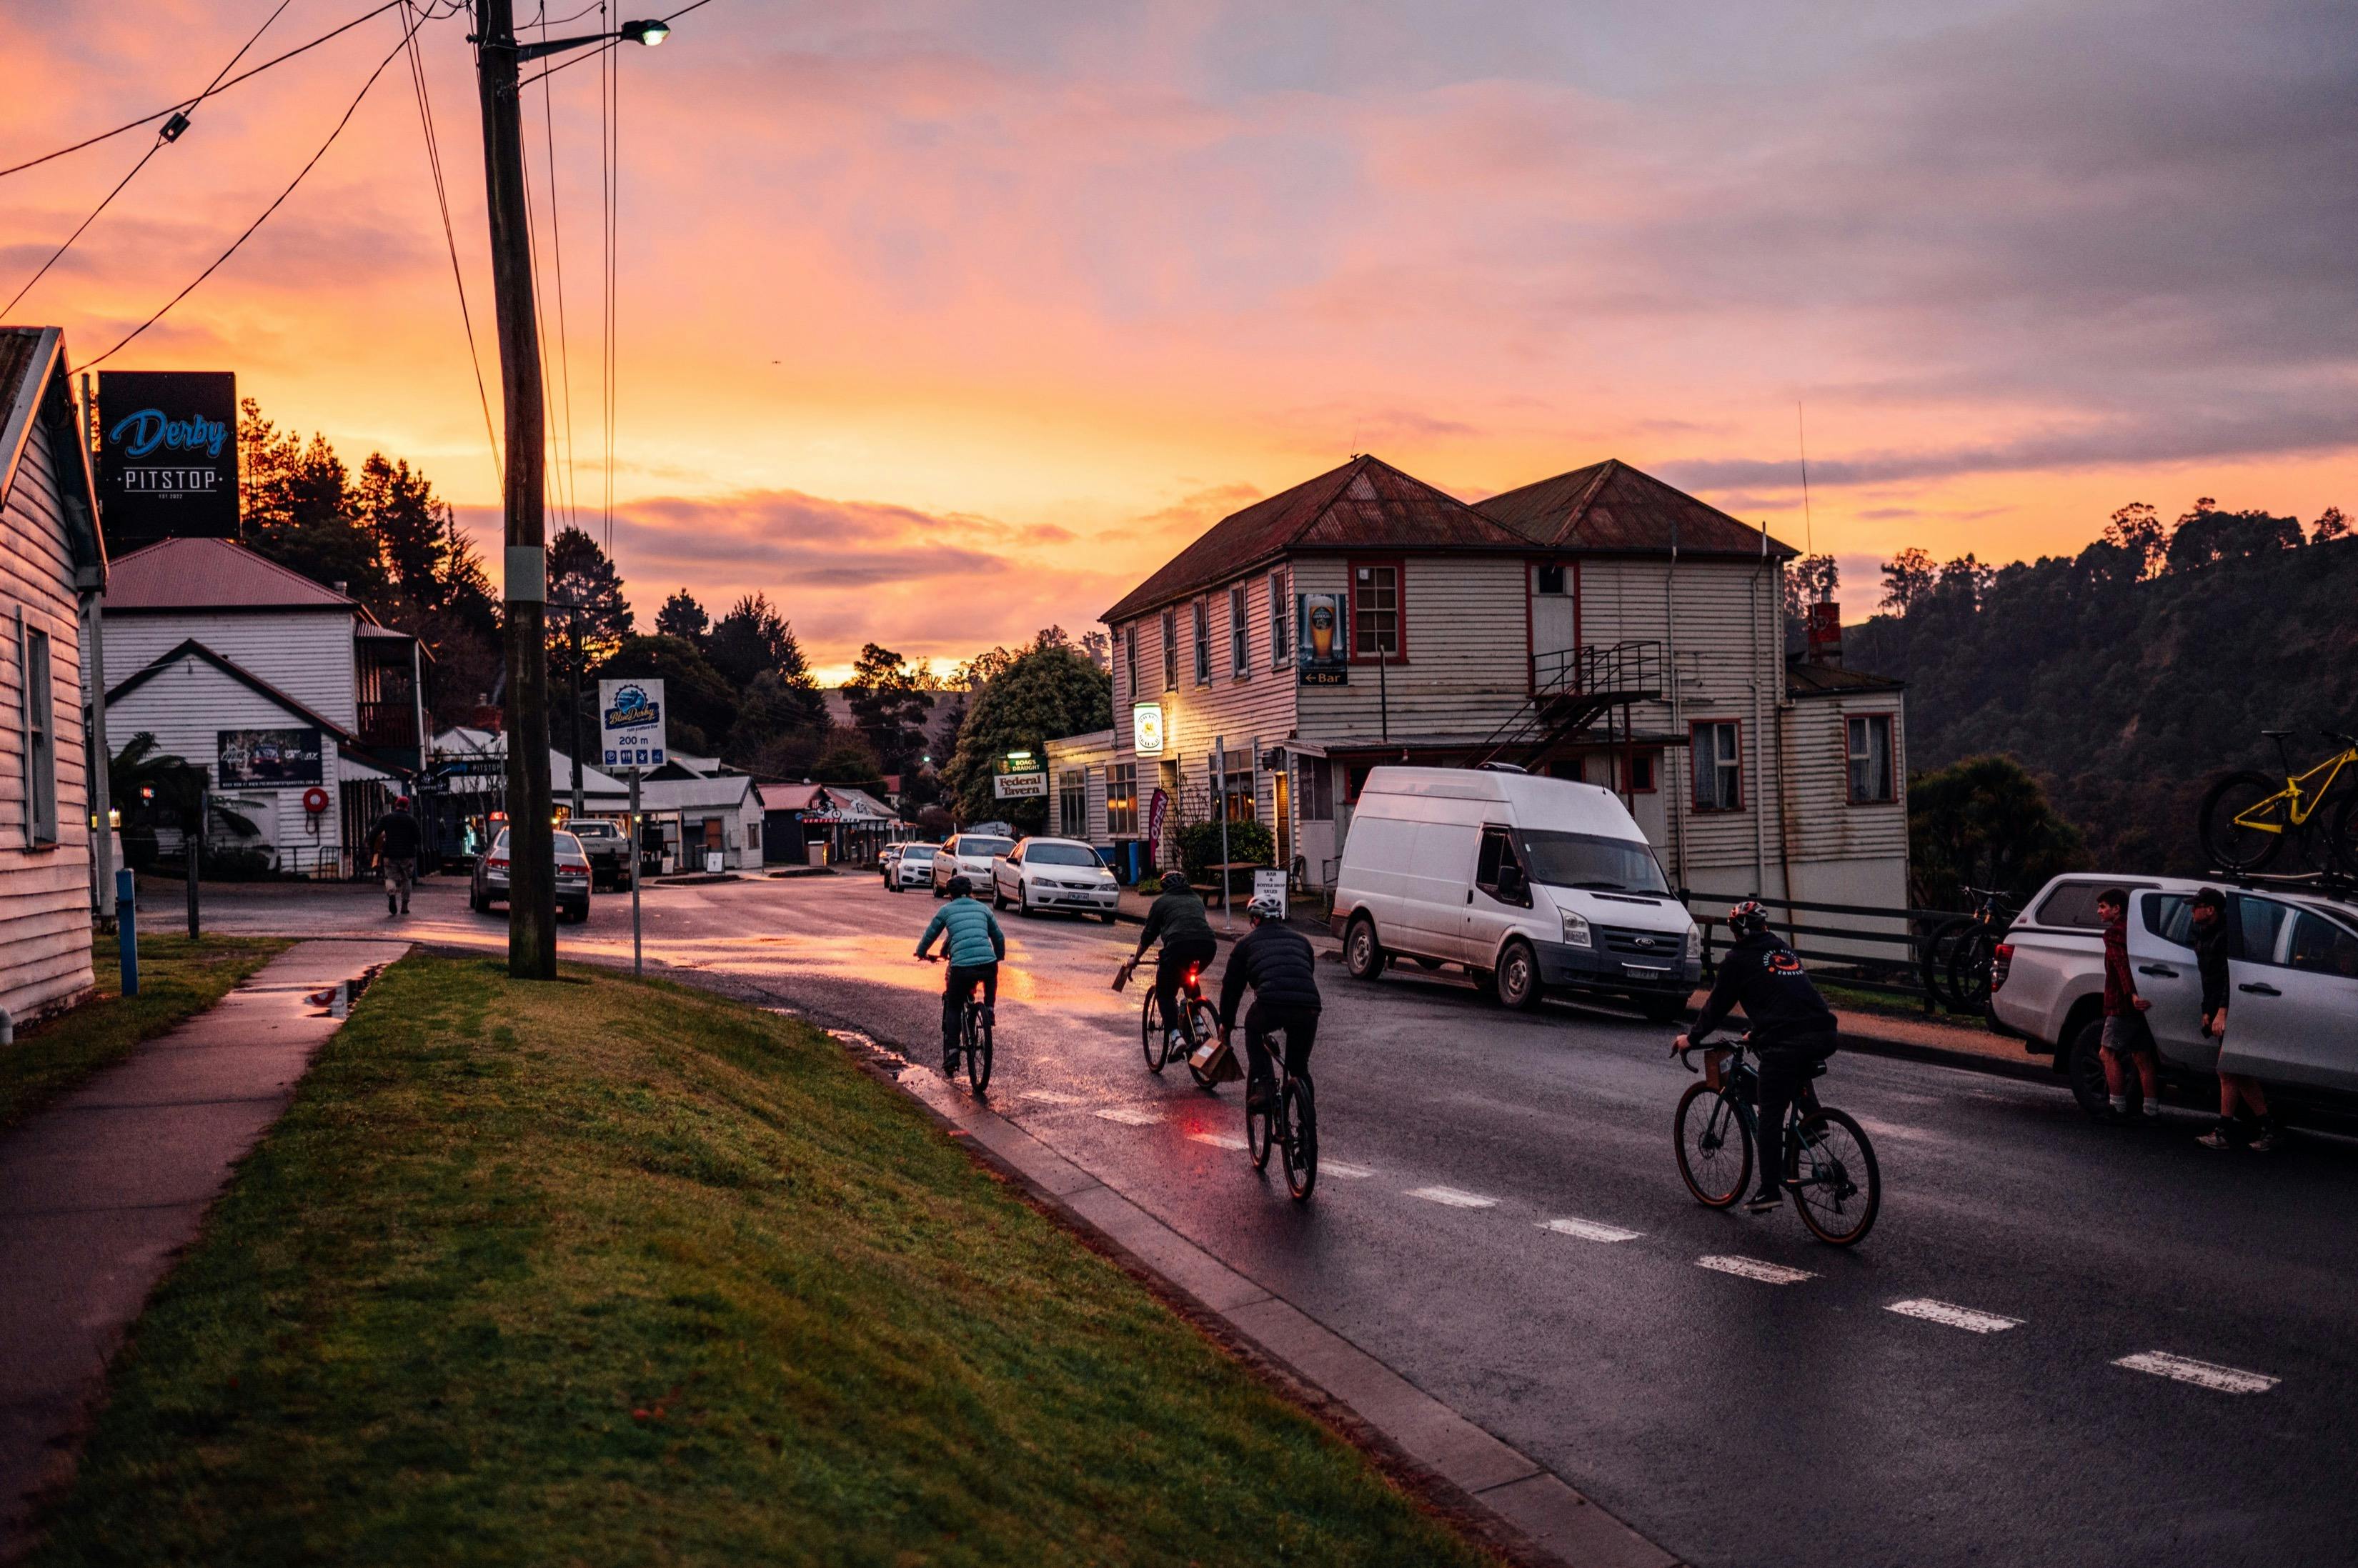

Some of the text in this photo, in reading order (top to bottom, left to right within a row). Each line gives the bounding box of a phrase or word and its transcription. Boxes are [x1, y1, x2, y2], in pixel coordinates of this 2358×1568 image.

[109, 409, 228, 458] Derby
[126, 471, 214, 489] PITSTOP
[1318, 673, 1340, 683] Bar
[609, 705, 655, 725] Blue Derby
[619, 736, 637, 745] 200
[999, 774, 1042, 787] Federal
[1003, 787, 1040, 796] Tavern
[1151, 794, 1168, 839] OPEN
